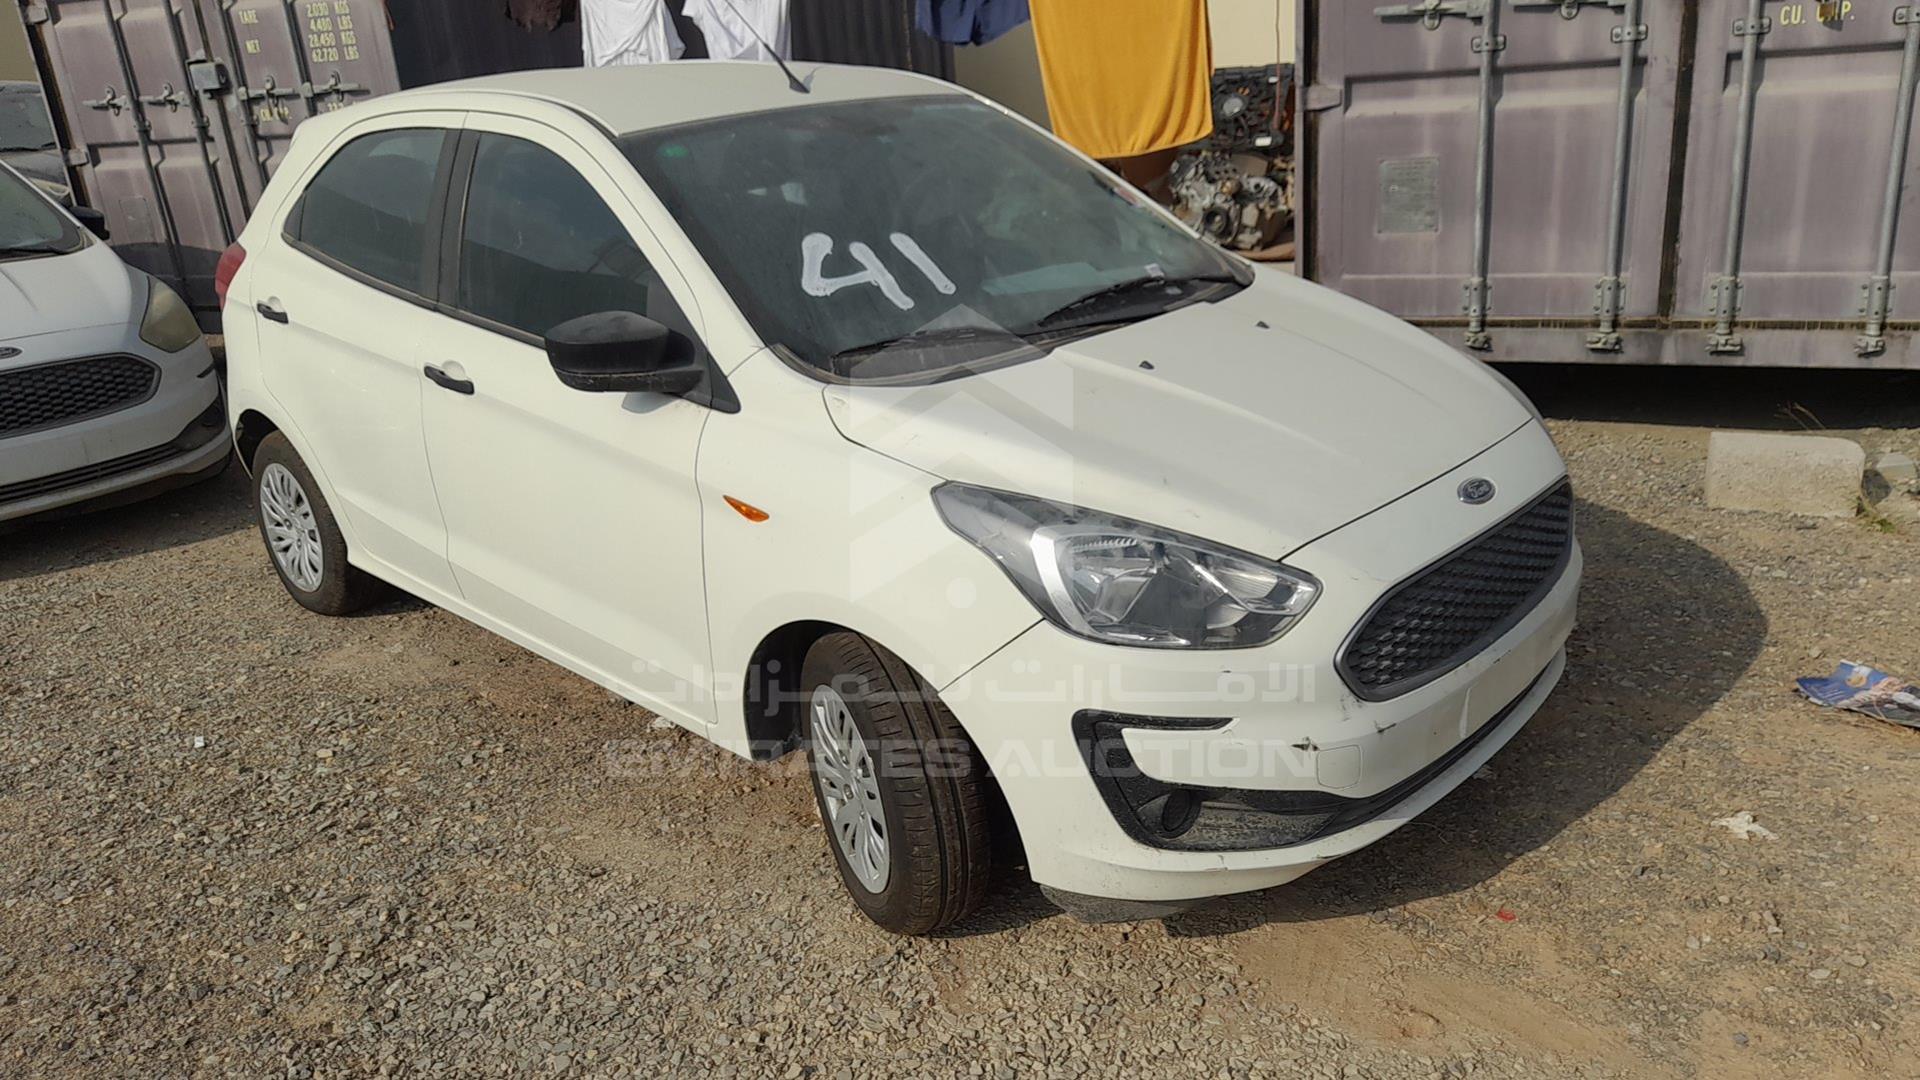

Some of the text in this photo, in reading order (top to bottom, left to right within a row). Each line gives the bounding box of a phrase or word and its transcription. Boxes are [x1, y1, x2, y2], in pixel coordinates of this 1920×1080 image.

[239, 9, 258, 24] TARE
[334, 0, 350, 14] KGS
[337, 14, 353, 30] LBS
[1780, 4, 1806, 25] CU.
[245, 39, 261, 54] NET
[340, 30, 357, 45] KGS
[343, 45, 359, 60] LBS
[801, 231, 957, 310] 41
